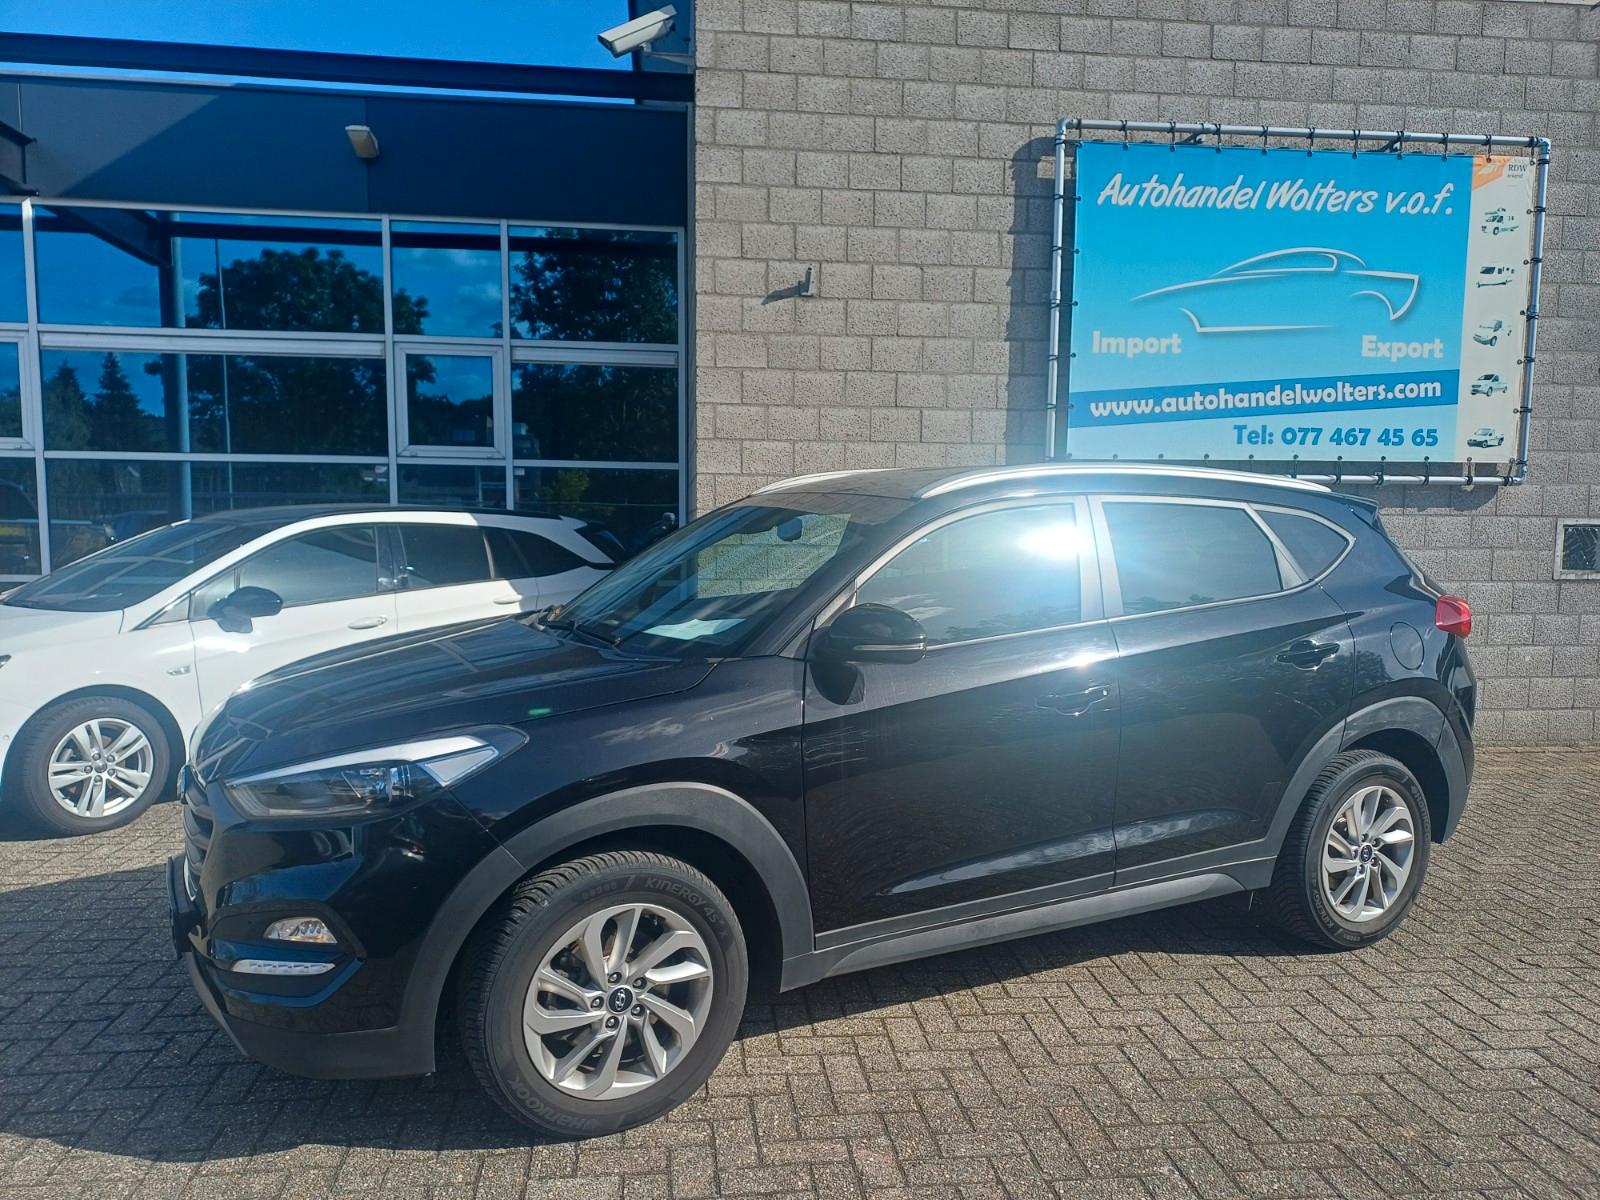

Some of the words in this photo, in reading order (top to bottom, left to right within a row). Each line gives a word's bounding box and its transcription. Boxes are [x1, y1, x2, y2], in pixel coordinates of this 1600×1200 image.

[1508, 164, 1527, 172] RDW
[1097, 172, 1267, 210] Autohandel
[1265, 178, 1378, 213] Wolters
[1385, 182, 1454, 215] v.o.f.
[1092, 330, 1182, 358] Import
[1361, 335, 1444, 362] Export
[1090, 381, 1442, 417] www.autohandelwolters.com
[1233, 424, 1275, 445] Tel:
[1281, 427, 1323, 446] 077
[1329, 428, 1371, 446] 467
[1377, 428, 1405, 446] 45
[1411, 429, 1439, 447] 65
[644, 877, 706, 907] KINERGY
